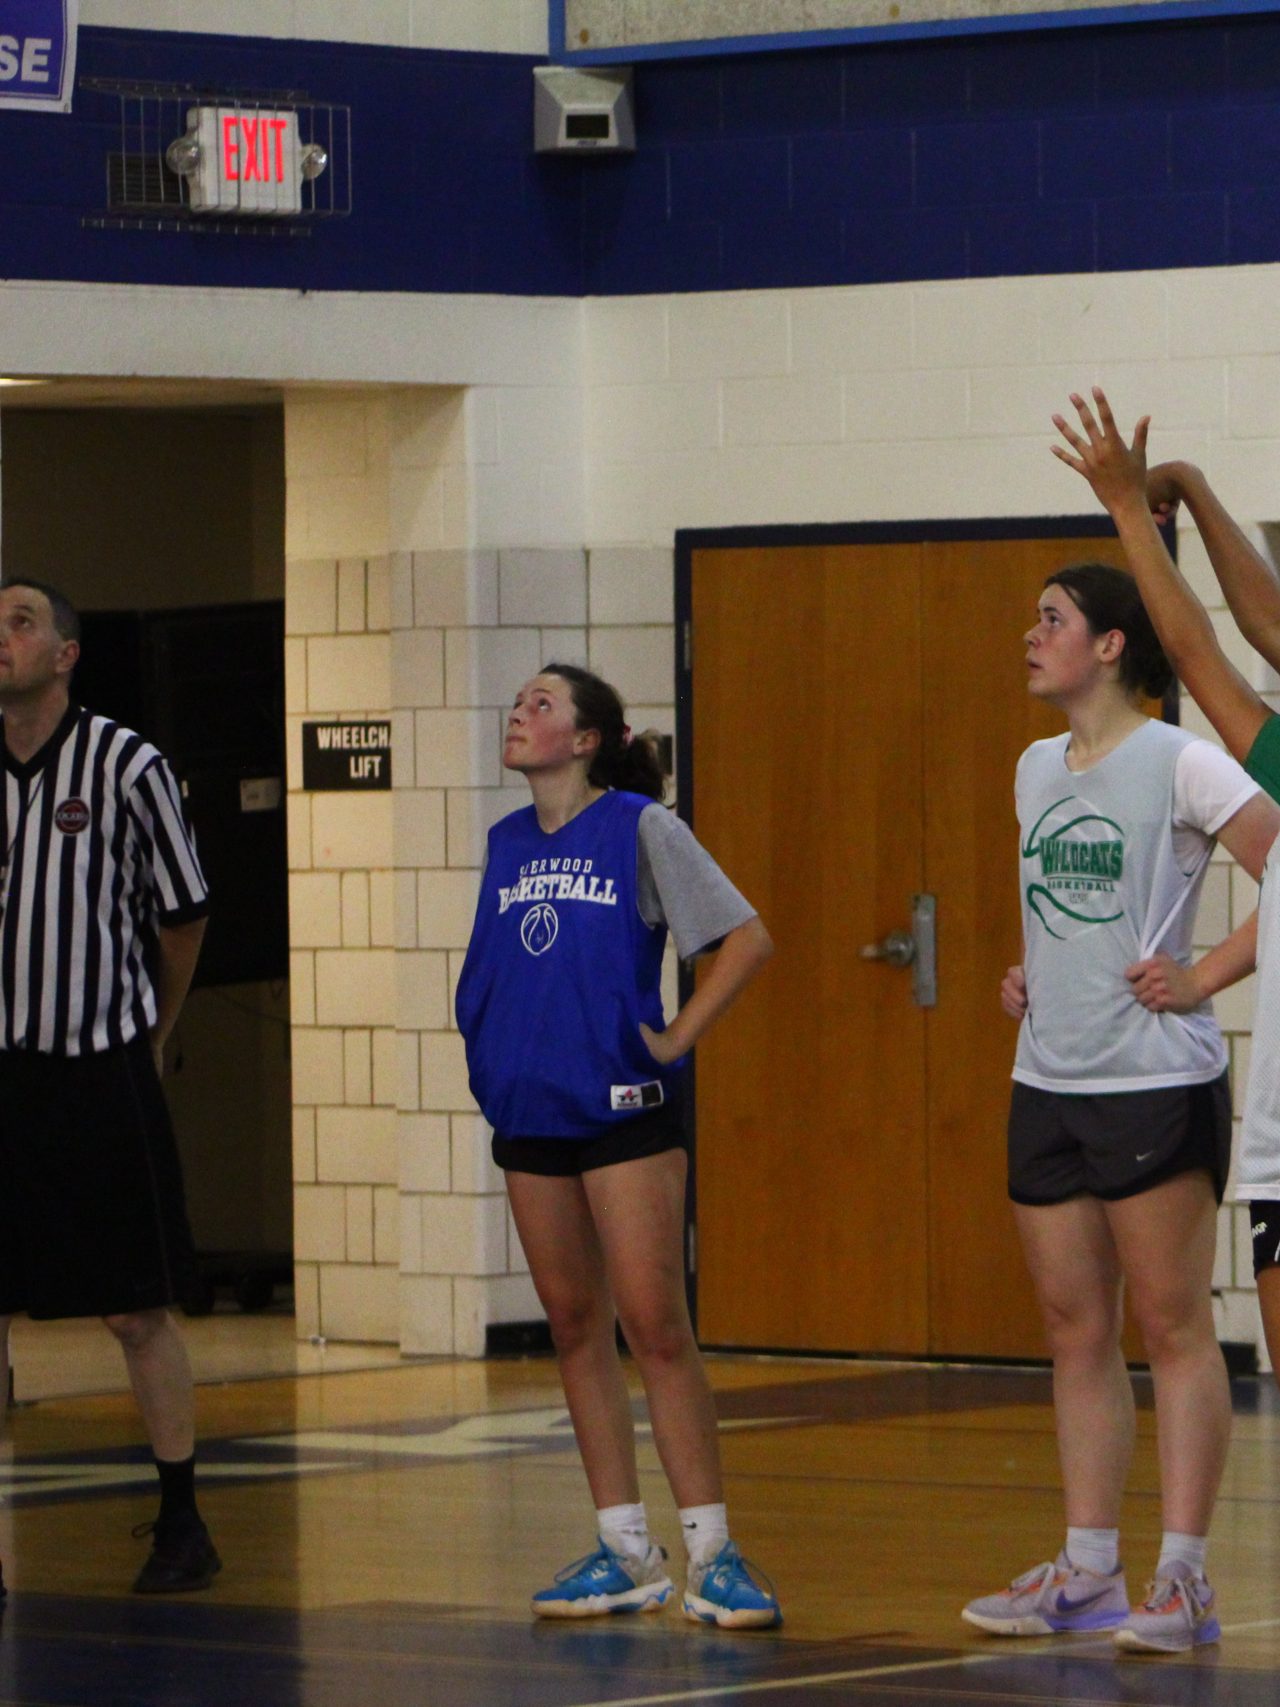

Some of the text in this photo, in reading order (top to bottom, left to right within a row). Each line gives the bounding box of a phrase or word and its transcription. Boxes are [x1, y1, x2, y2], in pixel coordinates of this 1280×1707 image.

[222, 116, 288, 184] EXIT
[316, 725, 388, 751] WHEELCH
[349, 755, 382, 779] LIFT
[1039, 836, 1124, 881] WILDCATS
